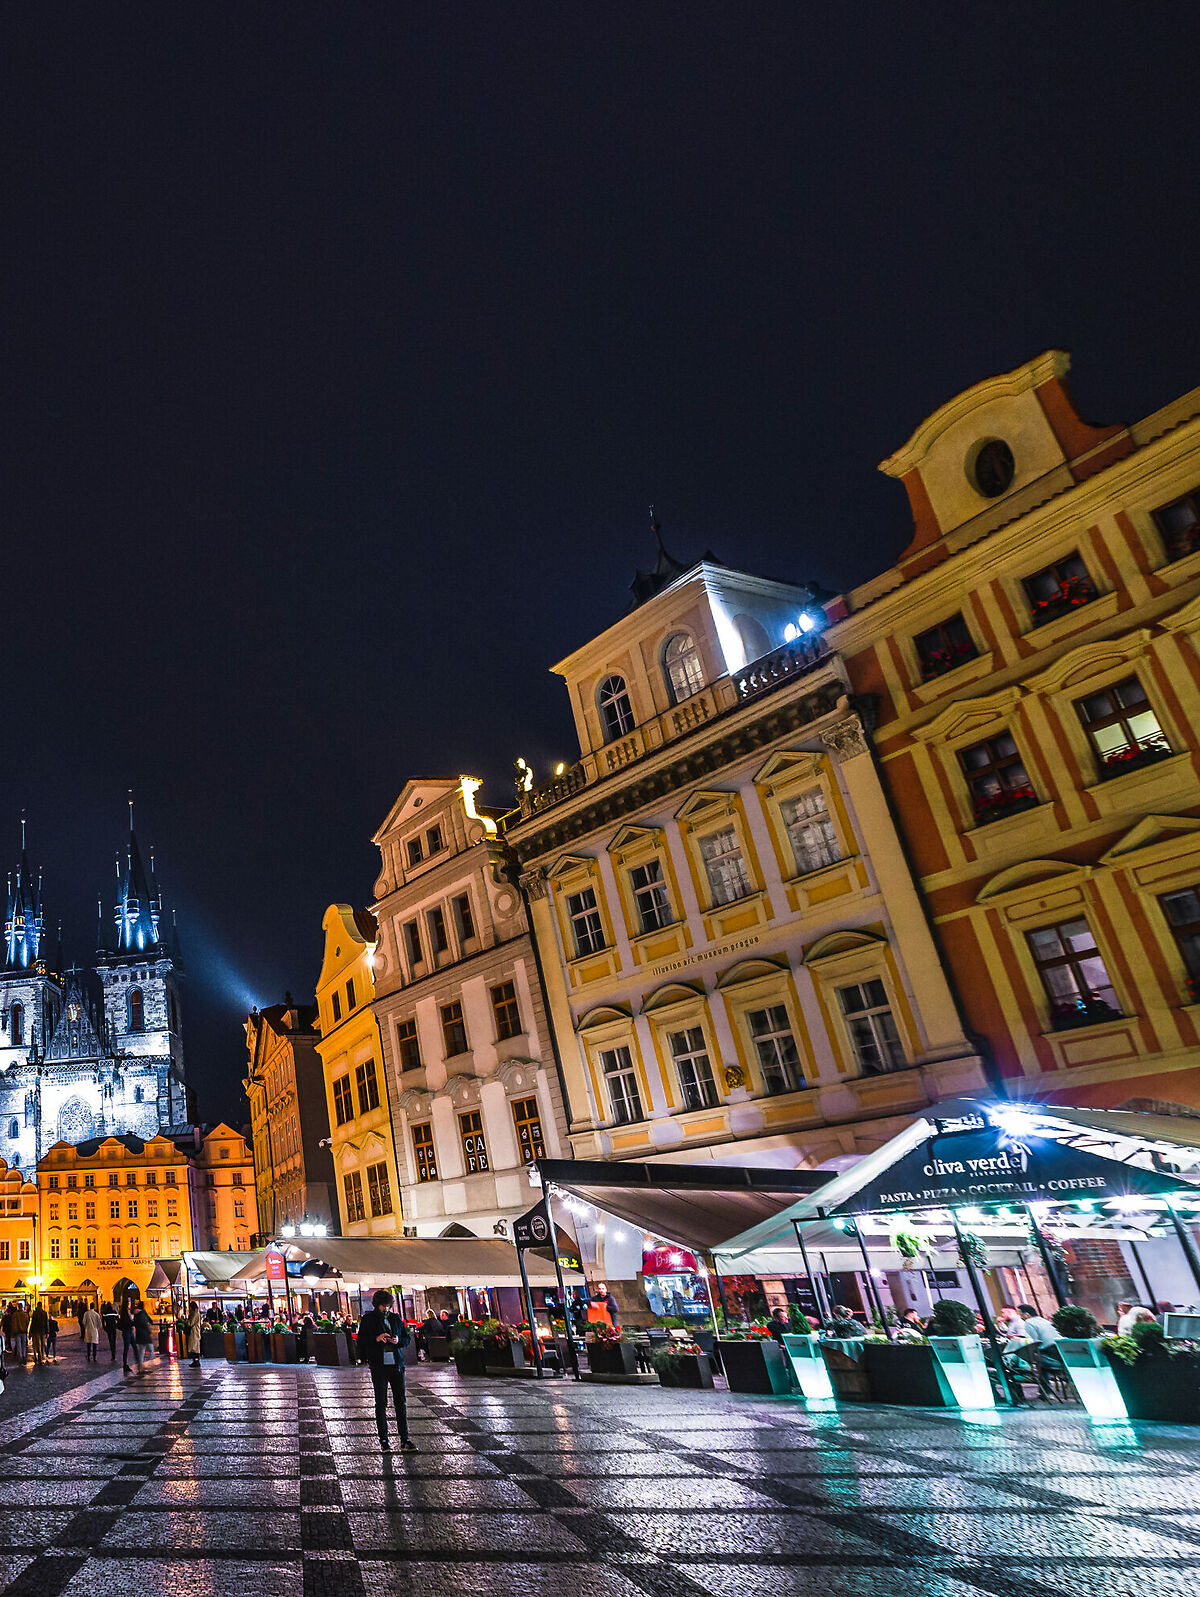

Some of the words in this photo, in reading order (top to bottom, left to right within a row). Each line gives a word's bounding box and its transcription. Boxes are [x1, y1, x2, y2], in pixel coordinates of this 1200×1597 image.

[652, 961, 682, 976] illusion
[683, 956, 695, 966] art
[697, 946, 729, 961] museum
[730, 936, 759, 952] prague
[923, 1160, 965, 1177] oliva
[966, 1151, 1021, 1172] verde
[879, 1192, 915, 1204] PASTA
[922, 1188, 957, 1200] PIZZA
[968, 1182, 1037, 1196] COCKTAIL
[1048, 1176, 1107, 1191] COFFEE
